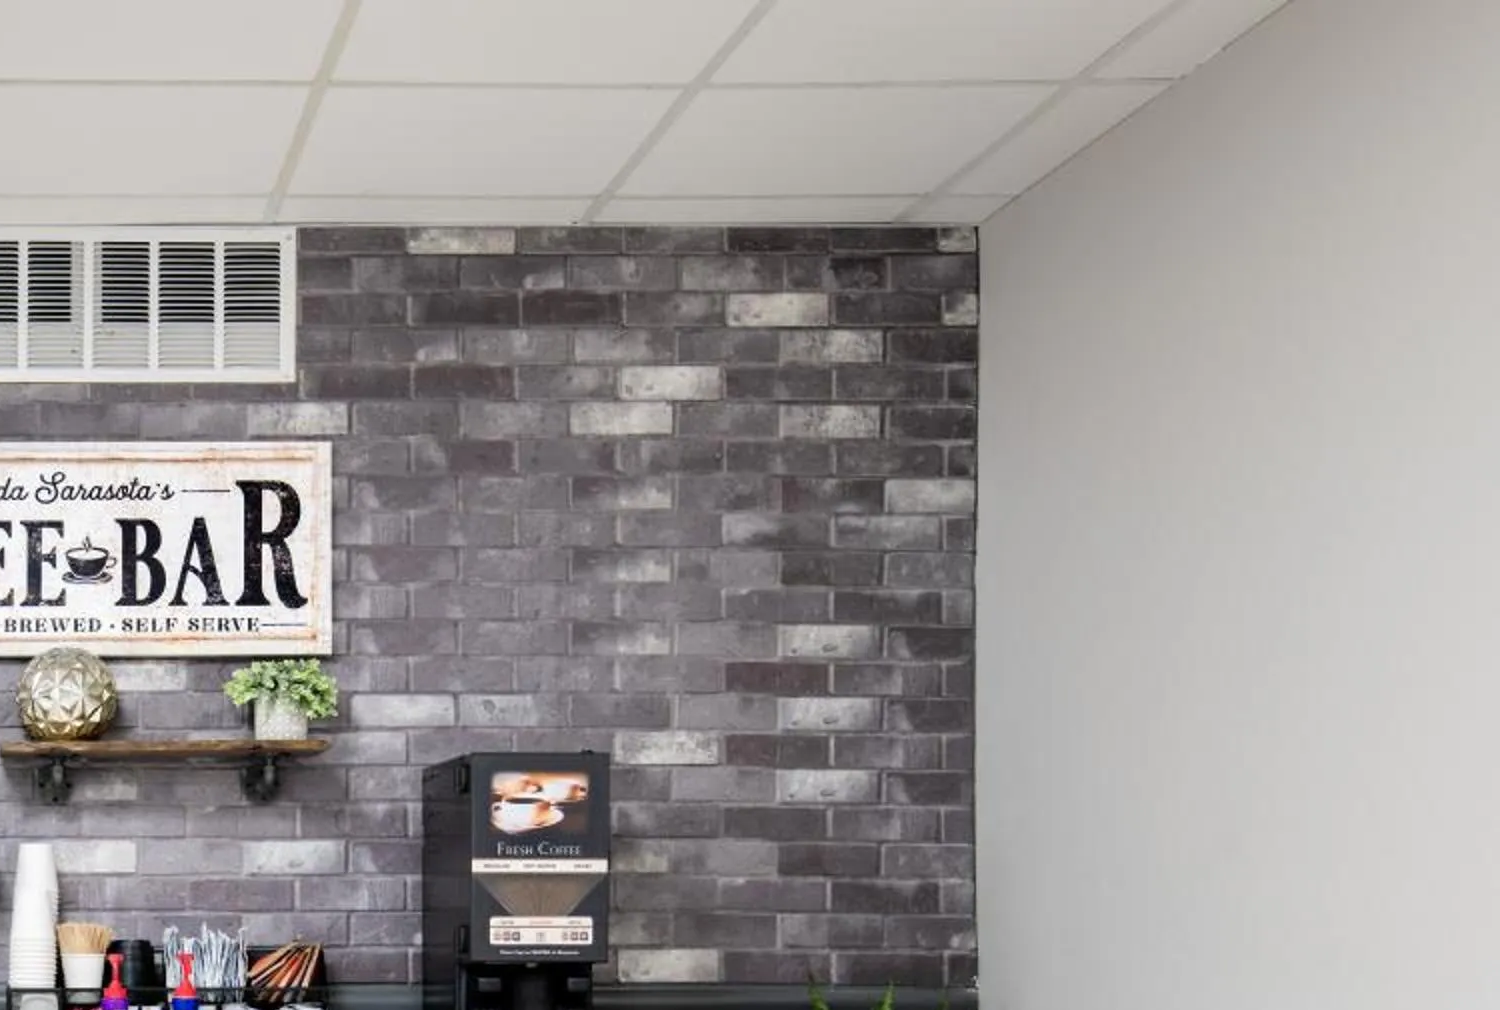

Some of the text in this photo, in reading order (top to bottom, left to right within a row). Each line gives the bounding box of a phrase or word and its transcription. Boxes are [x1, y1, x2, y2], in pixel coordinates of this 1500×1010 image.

[35, 471, 175, 504] Sarasota's
[114, 479, 309, 610] BAR
[3, 617, 102, 634] BREWED
[121, 617, 179, 633] SELF
[187, 616, 261, 633] SERVE
